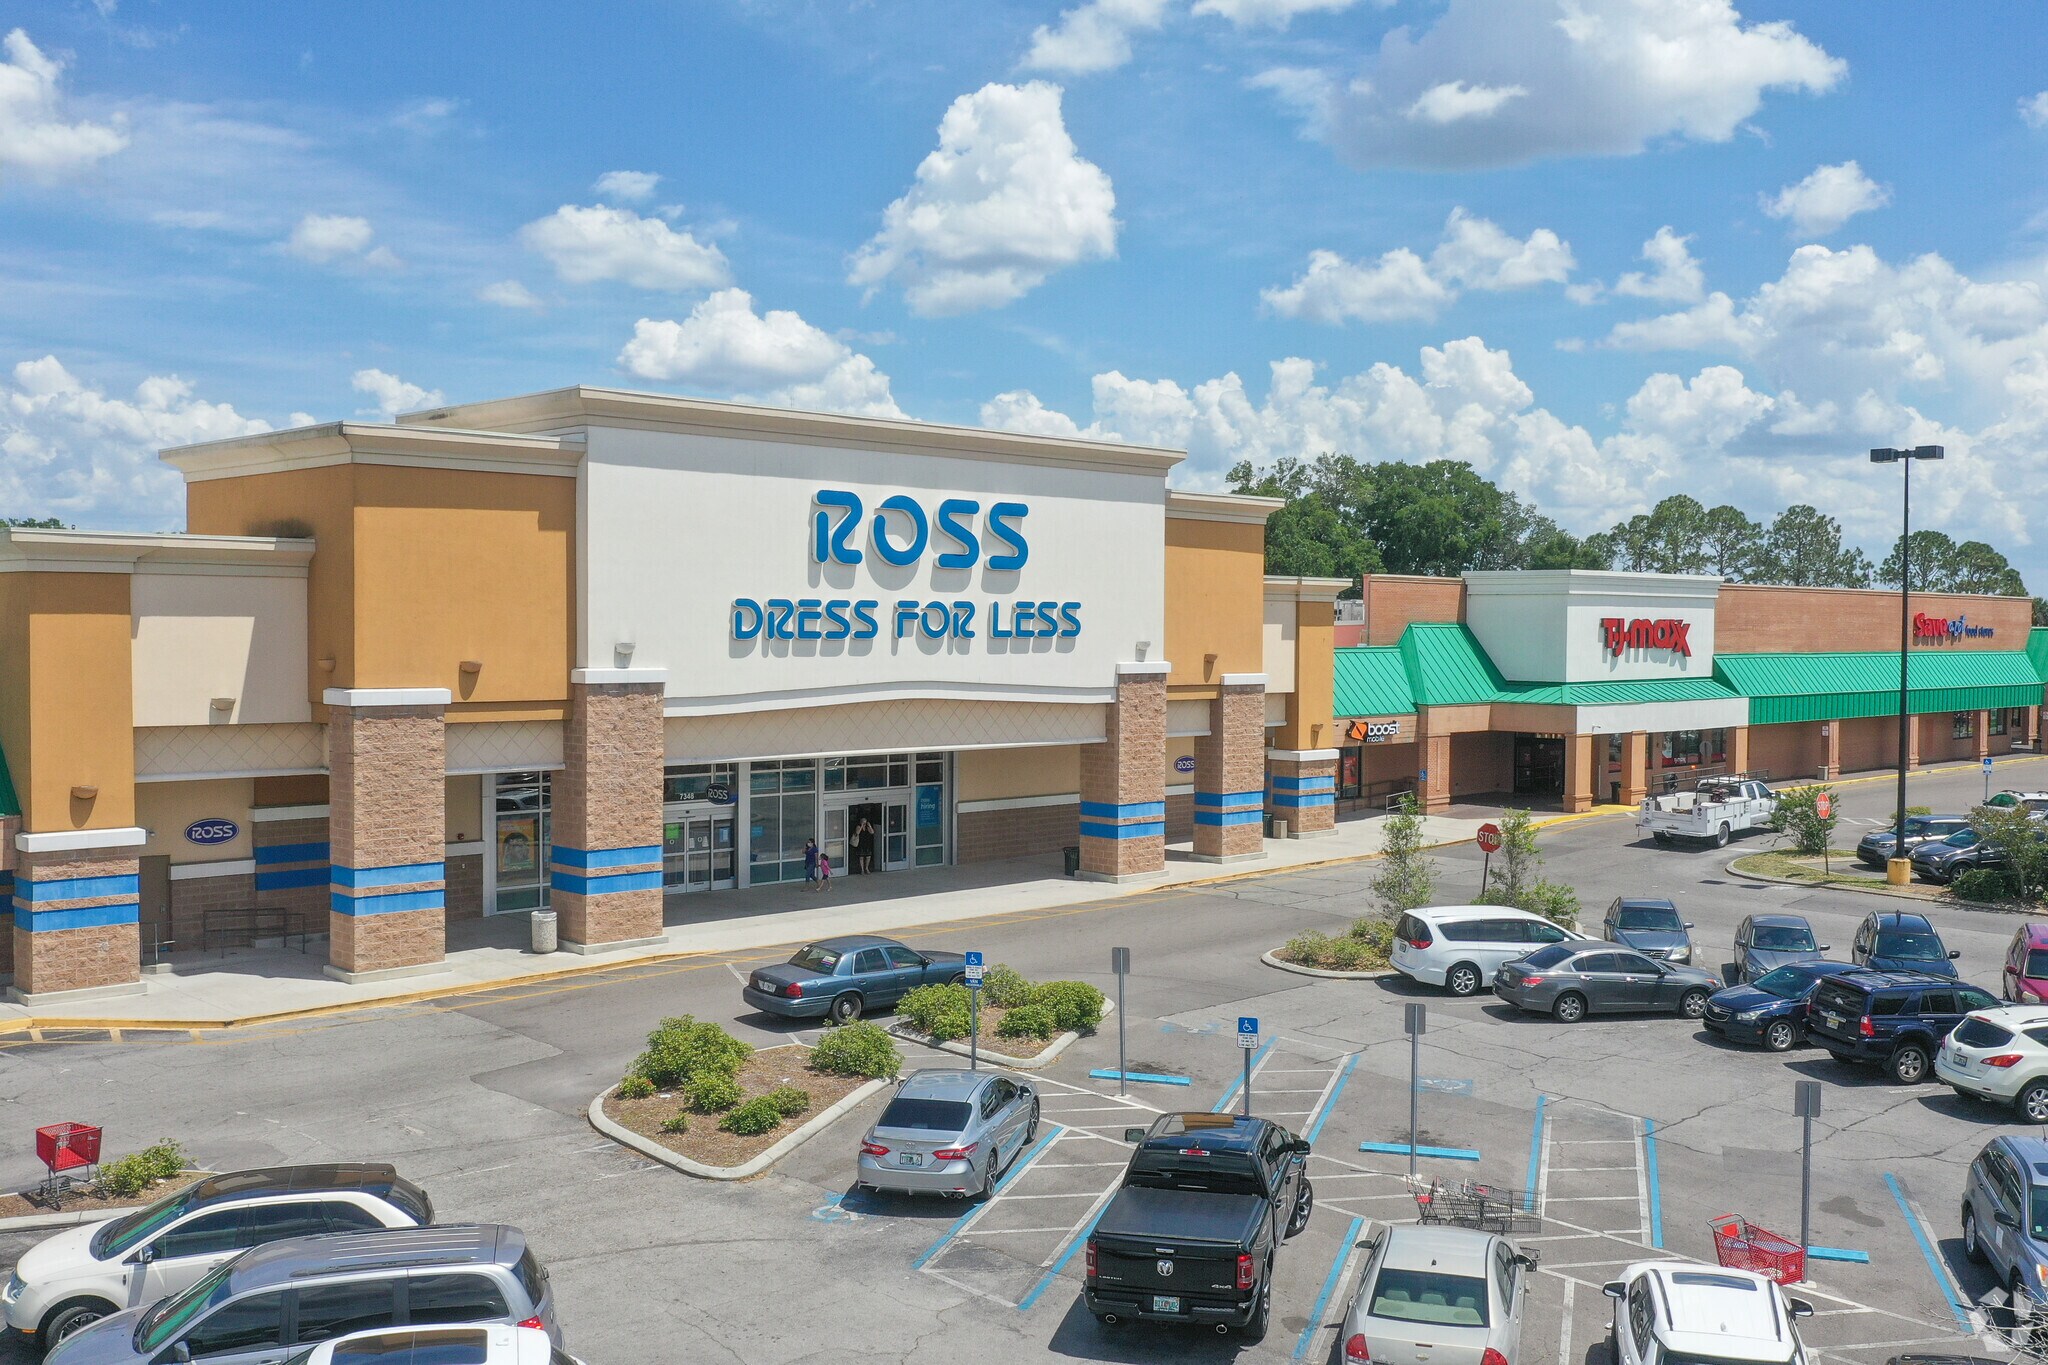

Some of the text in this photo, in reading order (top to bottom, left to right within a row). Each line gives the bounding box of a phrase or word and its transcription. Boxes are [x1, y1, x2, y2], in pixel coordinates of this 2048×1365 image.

[812, 489, 1029, 571] ROSS
[731, 598, 1082, 640] DRESS FOR LESS
[1914, 612, 1948, 637] Save
[1368, 721, 1401, 736] boost
[679, 792, 695, 801] 7348
[708, 788, 728, 800] ROSS
[920, 803, 936, 811] hiring
[191, 825, 233, 839] ROSS
